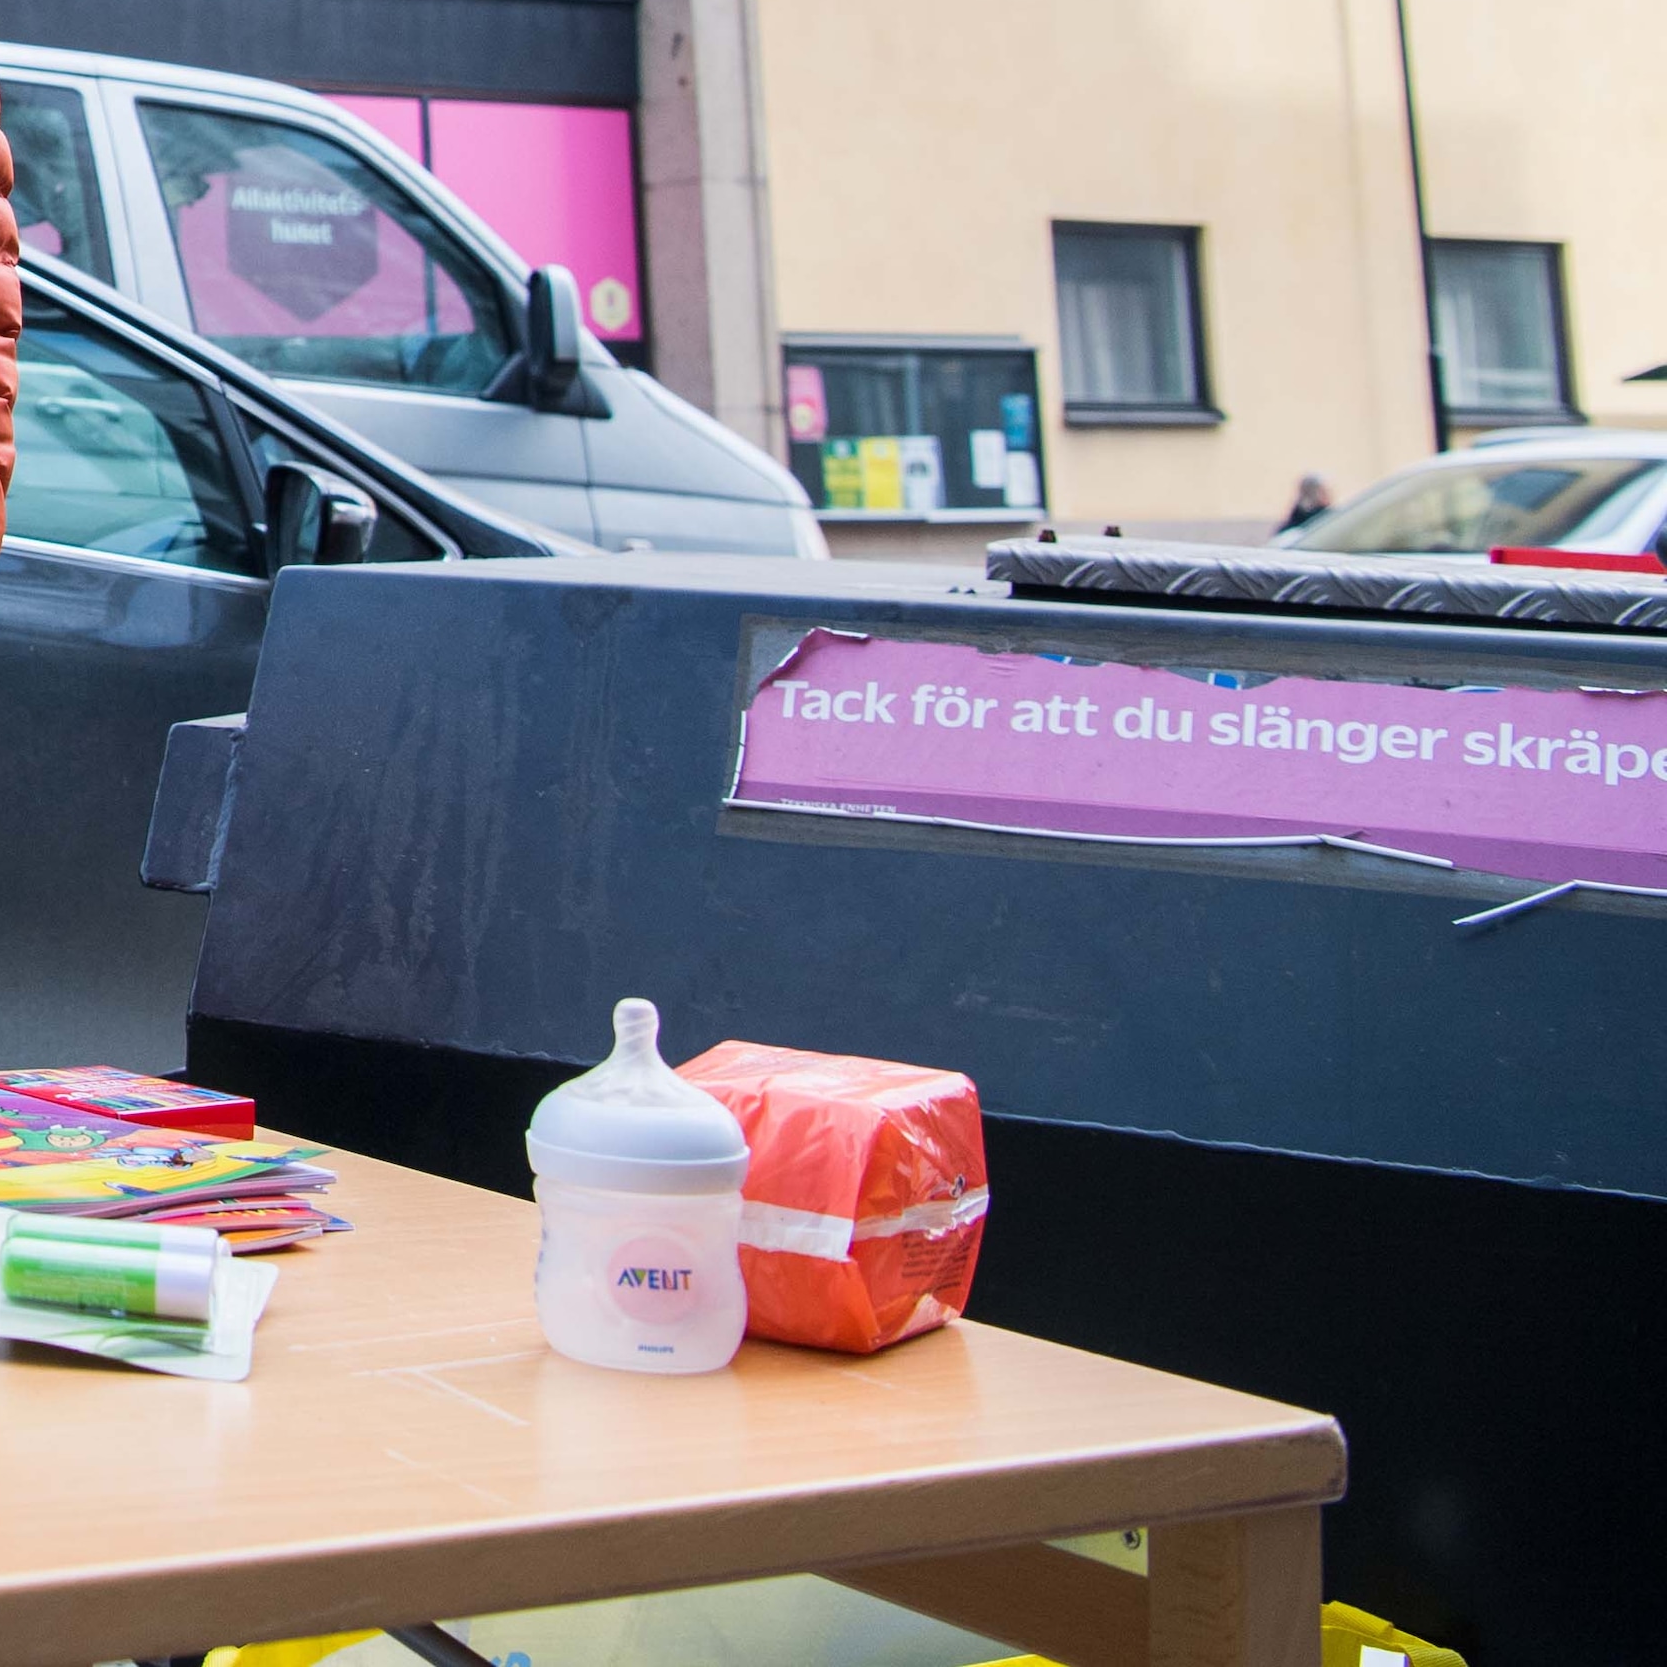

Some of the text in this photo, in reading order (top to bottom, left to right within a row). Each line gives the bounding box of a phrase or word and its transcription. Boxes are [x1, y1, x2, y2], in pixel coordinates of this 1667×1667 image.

[772, 679, 896, 725] Tack
[911, 683, 998, 729] för
[1009, 693, 1099, 737] att
[1112, 697, 1193, 744] du
[1208, 703, 1449, 765] slänger
[616, 1267, 694, 1292] AVENT
